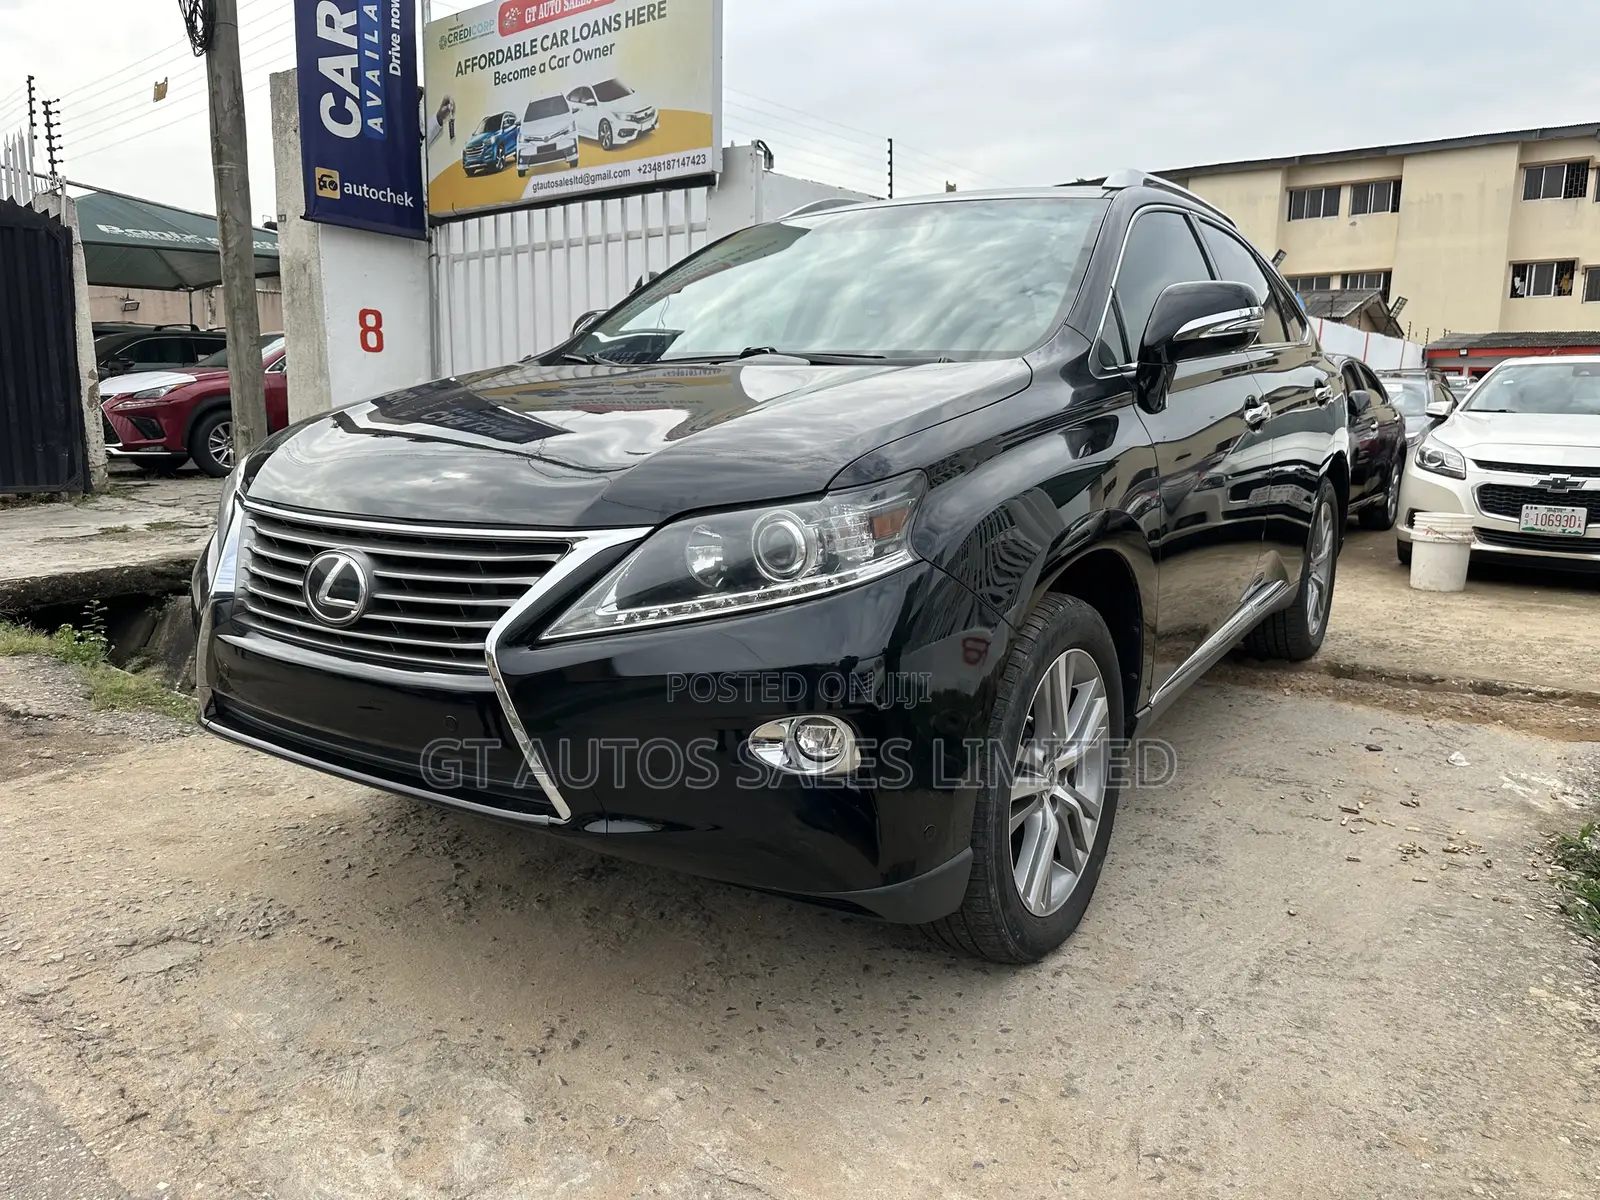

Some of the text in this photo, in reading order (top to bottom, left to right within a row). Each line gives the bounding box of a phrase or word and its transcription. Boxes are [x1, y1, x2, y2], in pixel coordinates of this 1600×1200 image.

[447, 19, 495, 43] CREDICORP
[525, 6, 537, 24] GT
[538, 0, 561, 20] AUTO
[389, 33, 401, 77] Drive
[455, 37, 538, 77] AFFORDABLE
[540, 29, 569, 52] CAR
[572, 13, 621, 43] LOANS
[625, 0, 667, 29] HERE
[316, 0, 362, 139] CAR
[363, 4, 384, 134] AVAILA
[493, 42, 616, 87] Become a Car Owner
[344, 181, 414, 208] autochek
[532, 167, 631, 193] gtautosalesltd@gmail.com
[358, 308, 385, 353] 8
